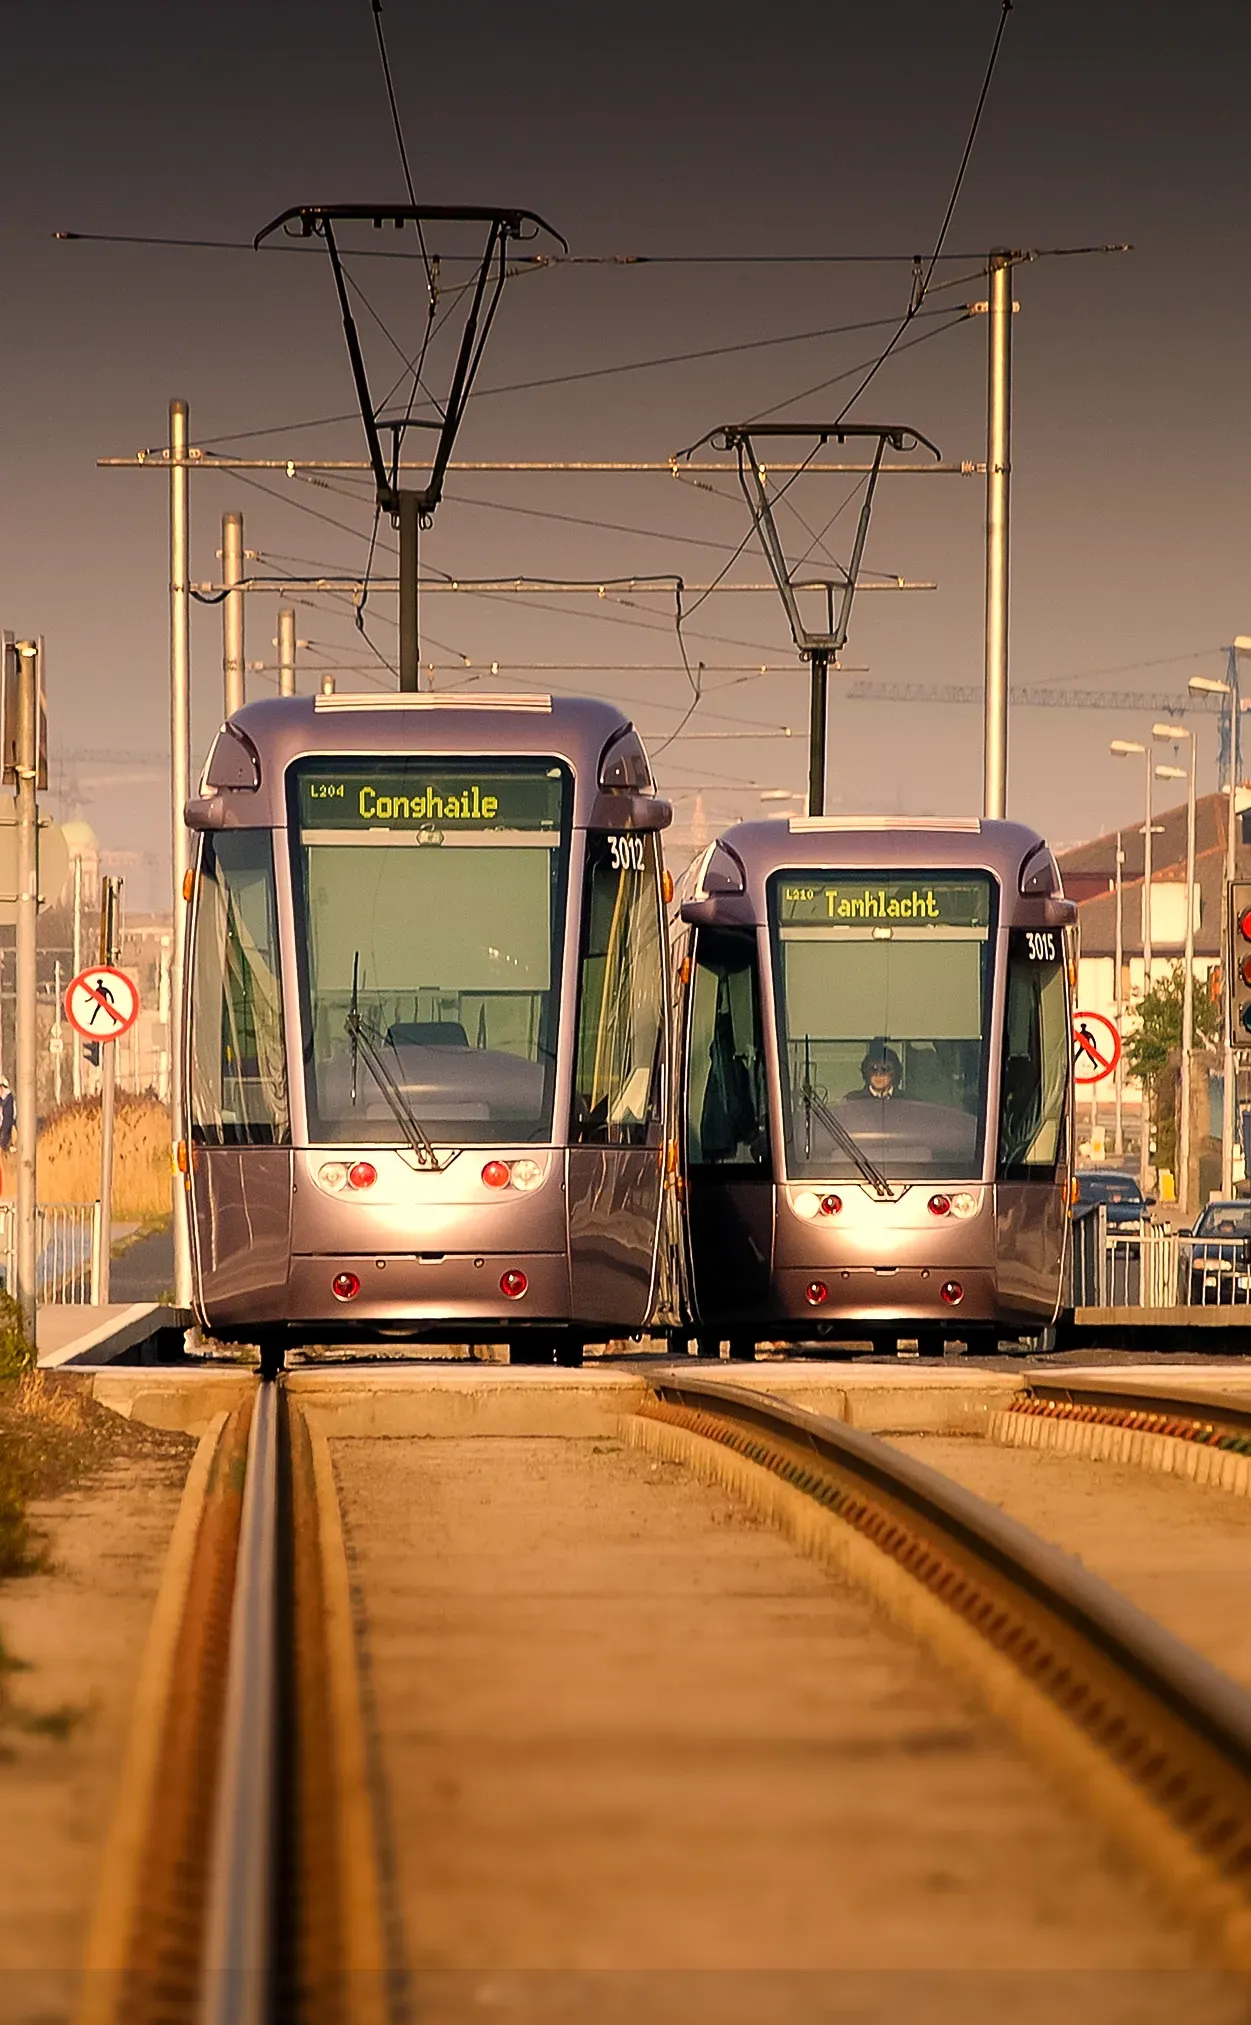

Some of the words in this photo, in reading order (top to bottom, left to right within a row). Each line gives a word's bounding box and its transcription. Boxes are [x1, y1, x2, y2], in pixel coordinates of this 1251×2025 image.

[310, 784, 345, 798] L204
[358, 786, 499, 820] Conghaile
[607, 836, 646, 871] 3012
[786, 888, 814, 901] L210
[825, 890, 940, 918] Tamhlacht
[1025, 932, 1056, 961] 3015
